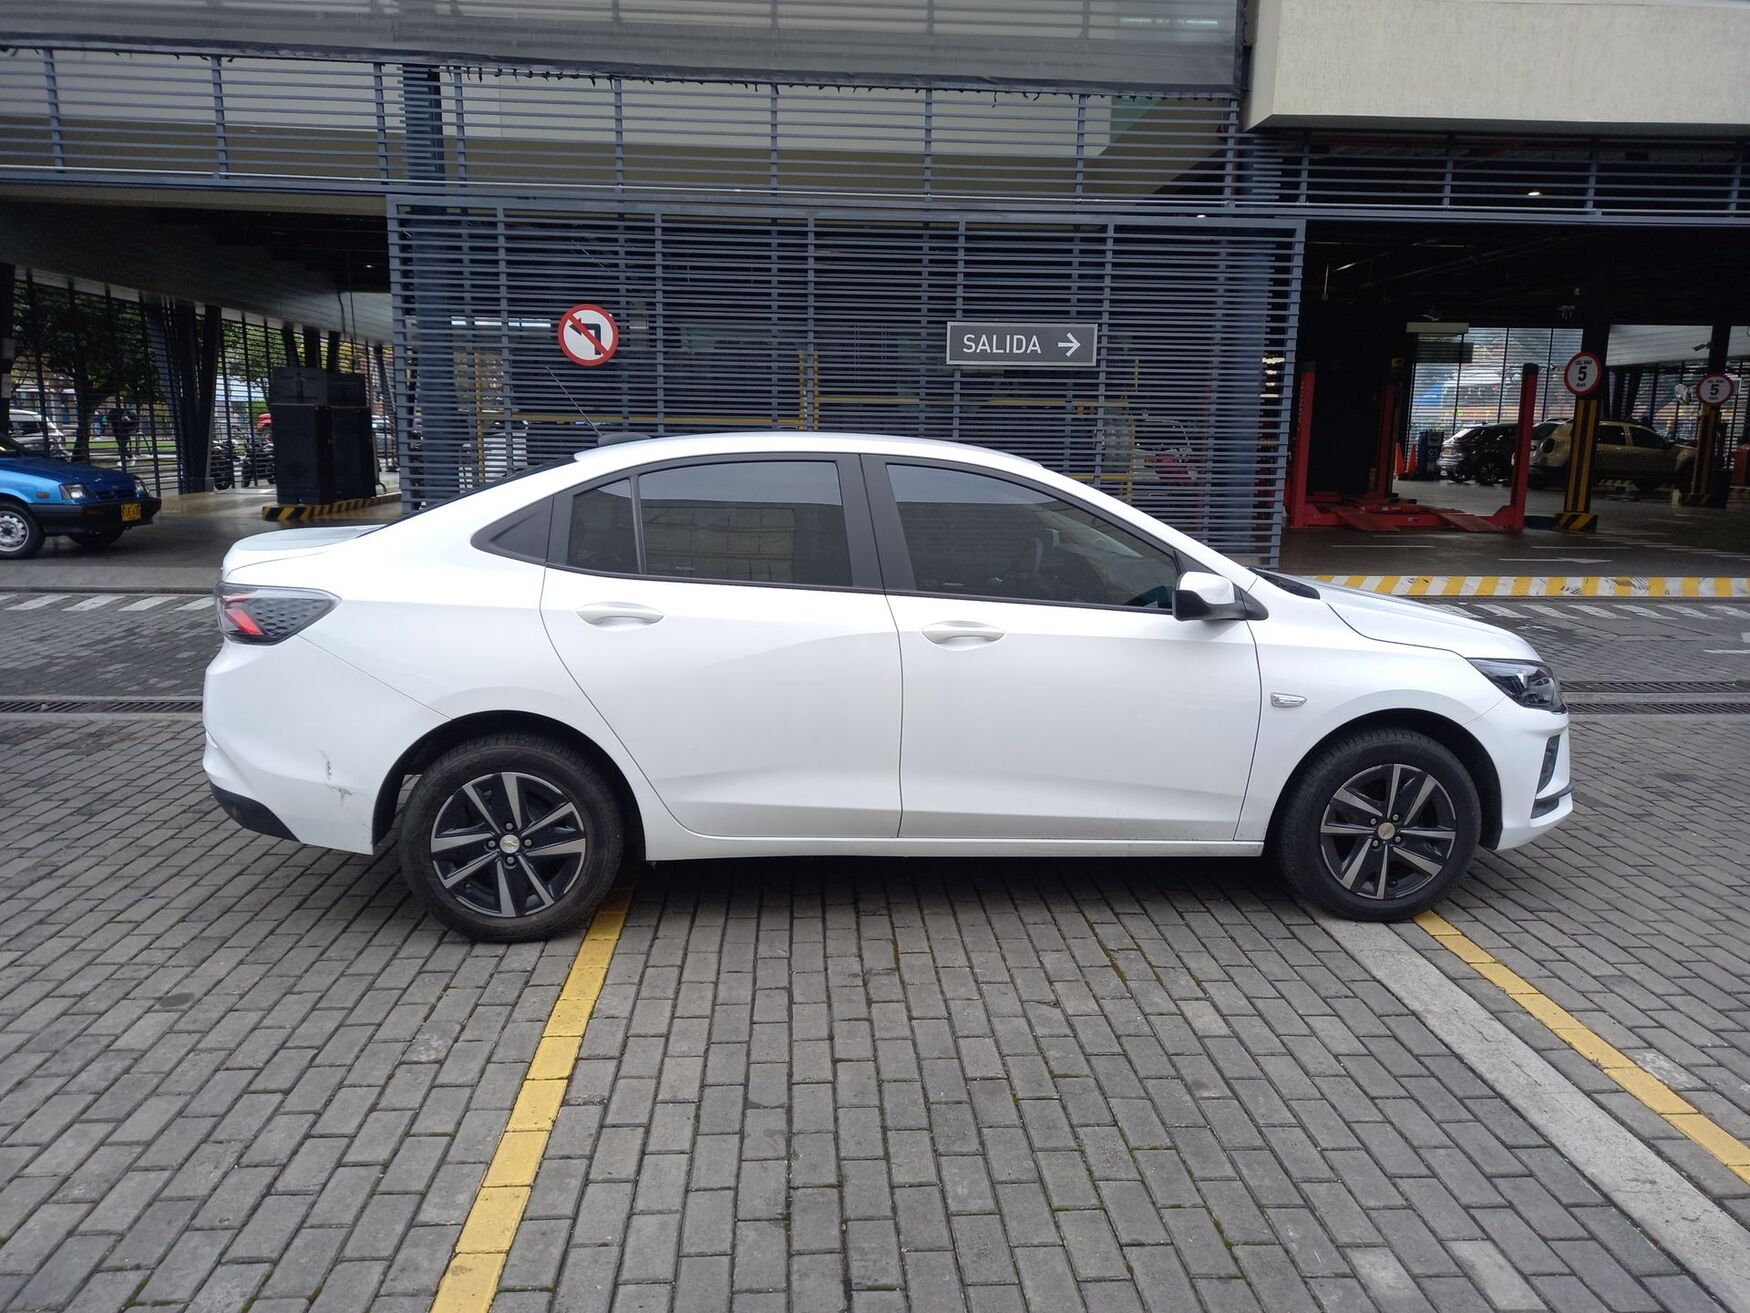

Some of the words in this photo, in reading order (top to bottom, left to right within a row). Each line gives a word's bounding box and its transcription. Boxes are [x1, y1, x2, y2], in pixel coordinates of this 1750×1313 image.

[962, 334, 1042, 354] SALIDA
[1577, 365, 1588, 382] 5
[1709, 383, 1720, 396] 5
